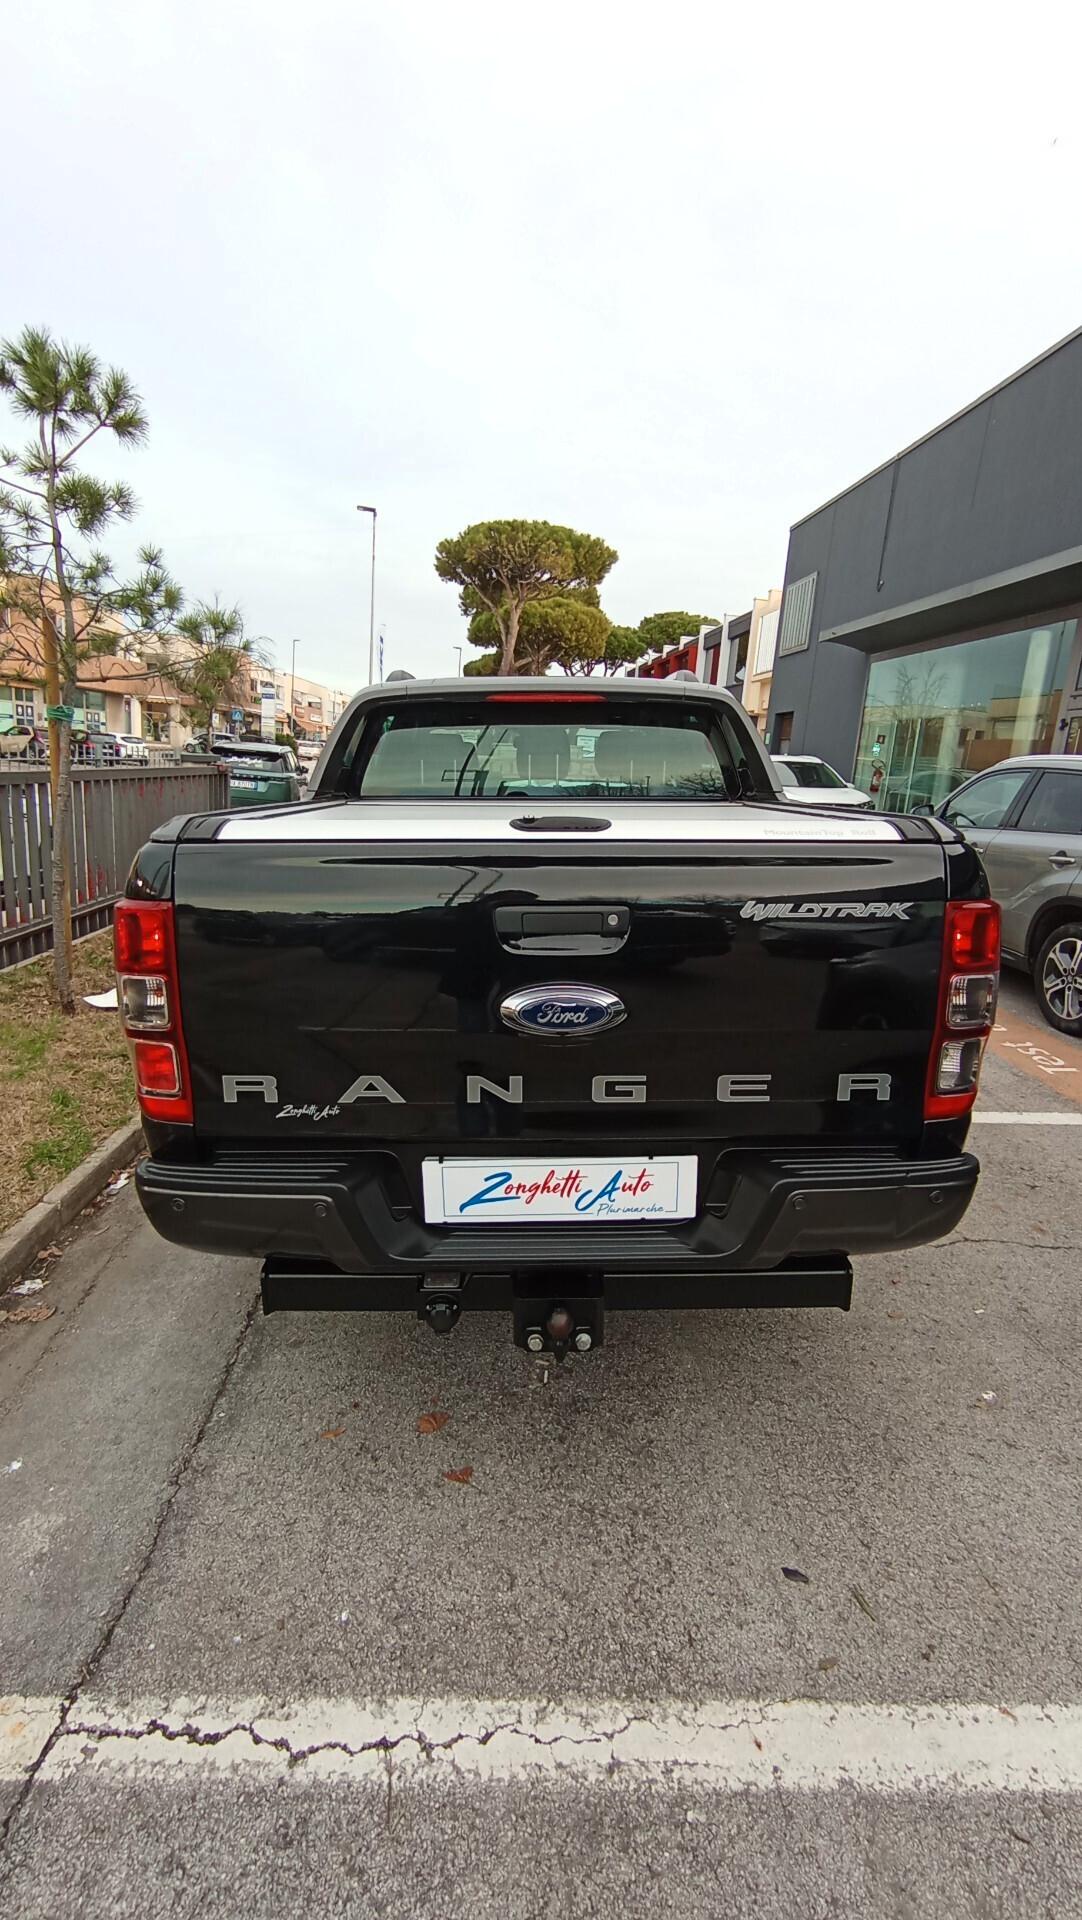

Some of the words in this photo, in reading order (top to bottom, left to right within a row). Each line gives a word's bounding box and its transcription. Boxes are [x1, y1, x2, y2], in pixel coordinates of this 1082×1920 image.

[740, 900, 914, 921] WILDTRAK
[537, 1001, 590, 1024] Ford
[222, 1074, 891, 1104] RANGER
[314, 1105, 341, 1121] Auto
[459, 1169, 589, 1214] Zonghetti
[575, 1167, 655, 1212] Auto
[597, 1203, 664, 1216] Plurimarche
